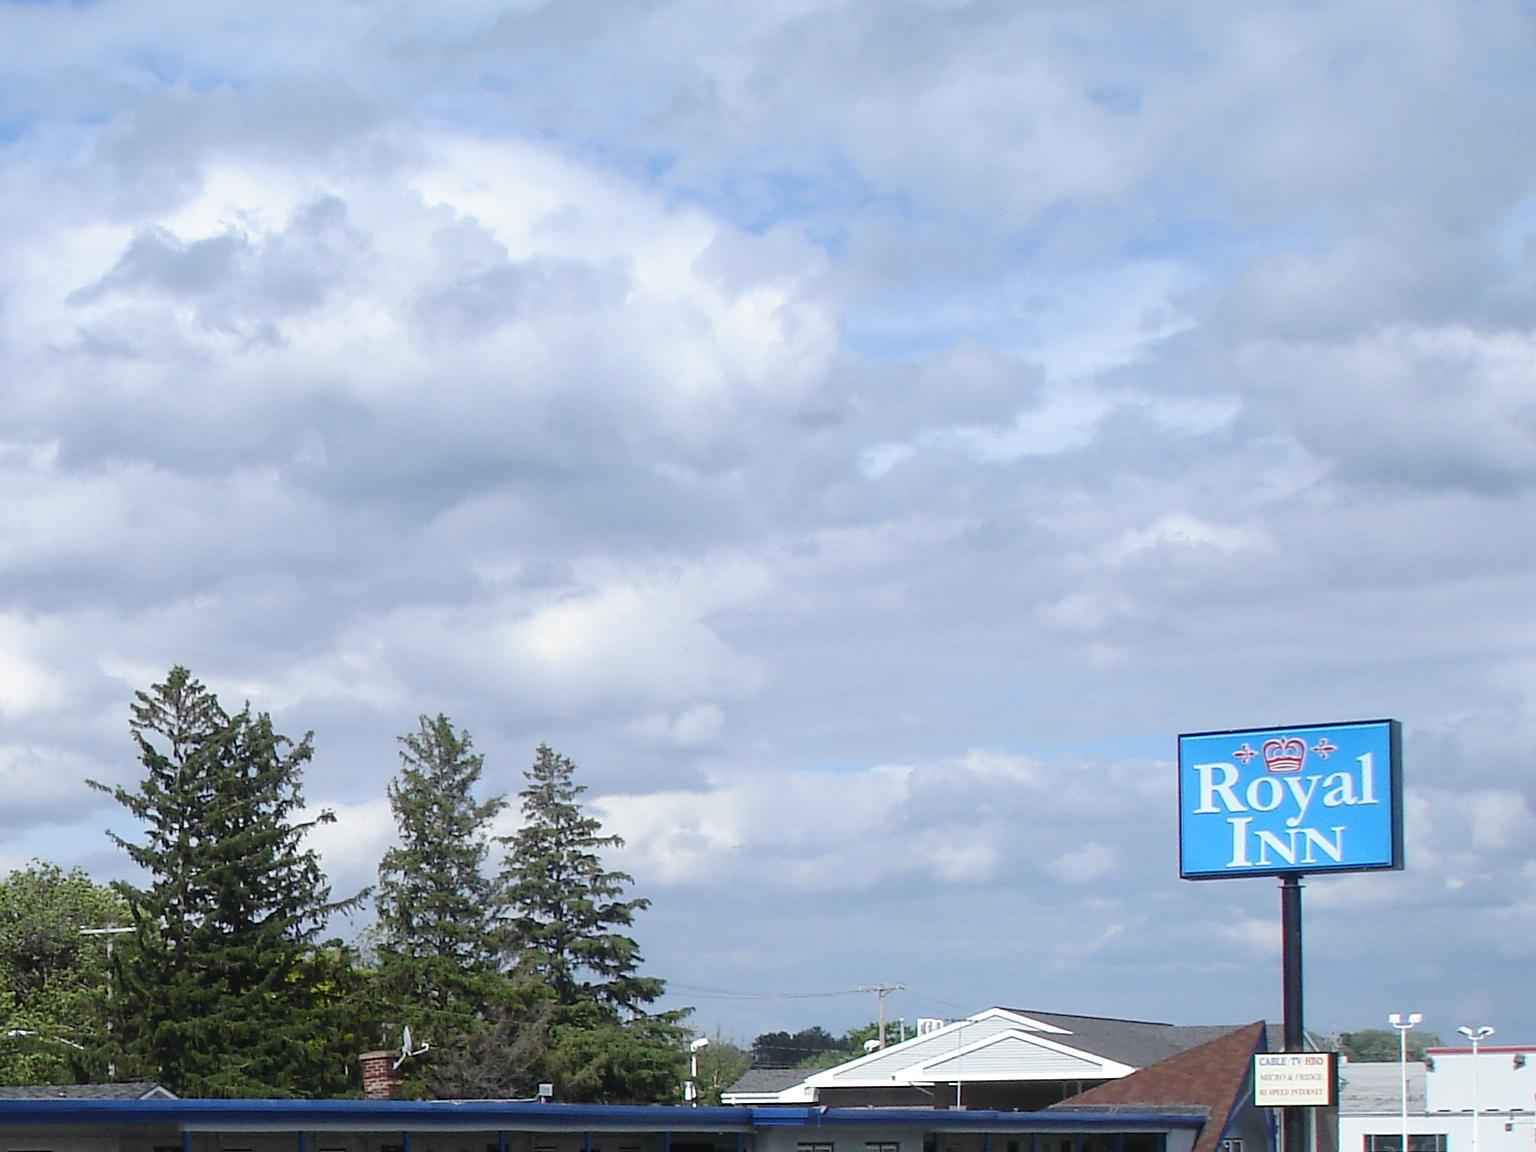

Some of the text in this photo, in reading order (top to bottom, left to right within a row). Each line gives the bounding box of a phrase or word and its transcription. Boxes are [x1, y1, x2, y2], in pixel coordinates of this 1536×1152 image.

[1193, 752, 1379, 827] Royal
[1259, 1057, 1324, 1066] CABLE TV HBO
[1260, 1073, 1285, 1081] MICRO
[1291, 1088, 1323, 1096] INTERNET
